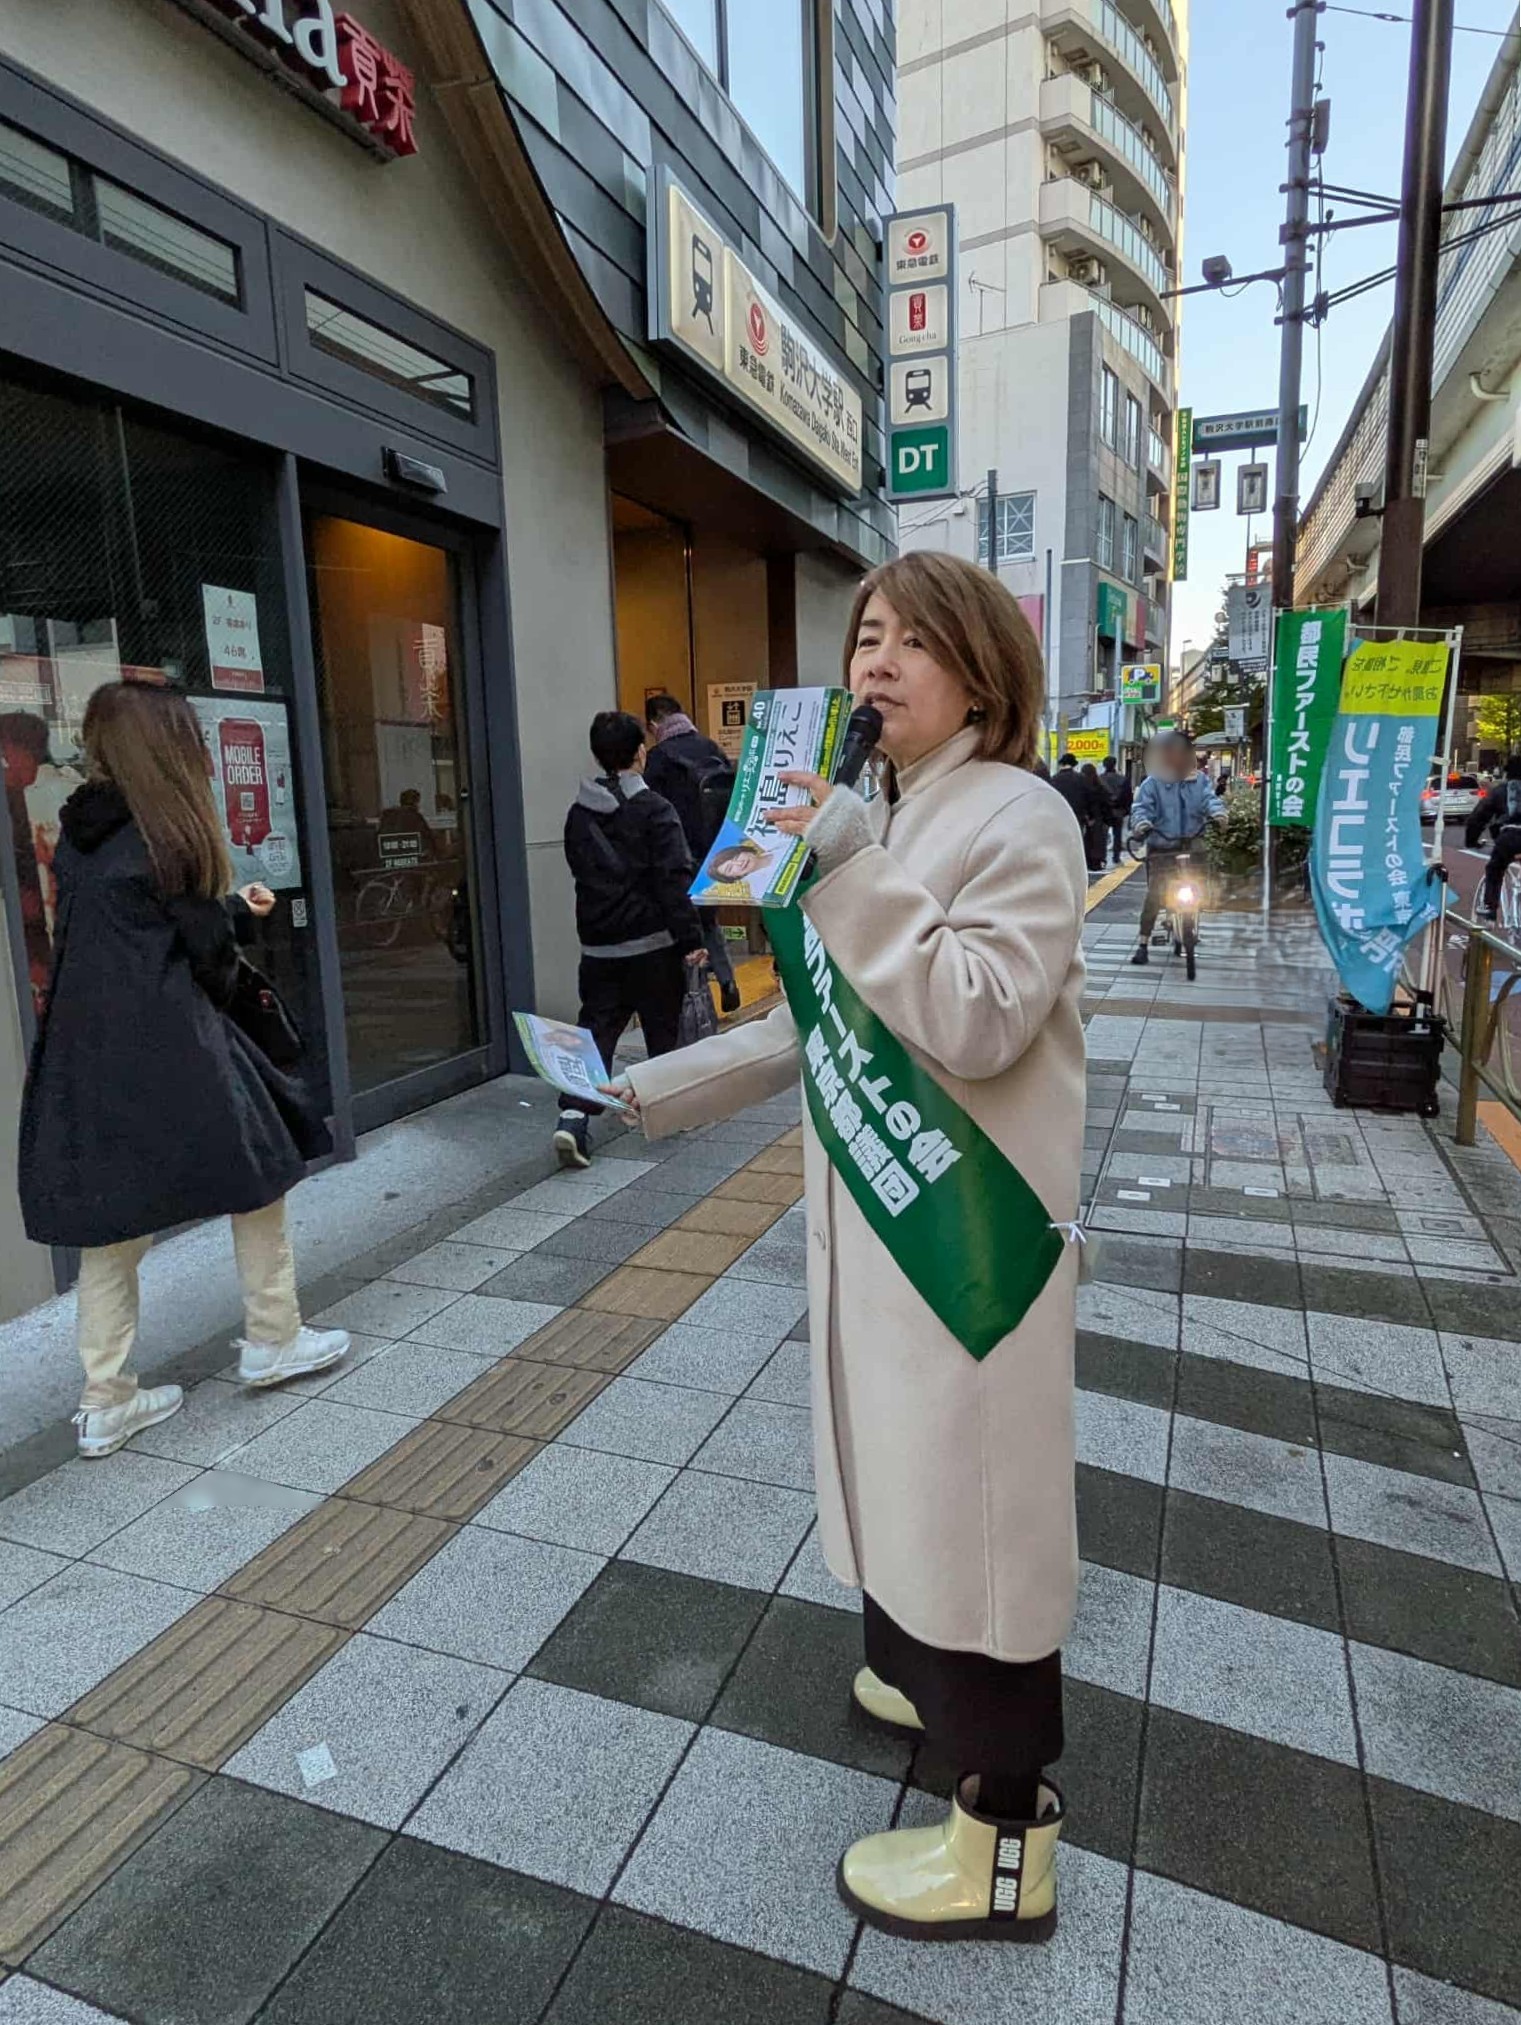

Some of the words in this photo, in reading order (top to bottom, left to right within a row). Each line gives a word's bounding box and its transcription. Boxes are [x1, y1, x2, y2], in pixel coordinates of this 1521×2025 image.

[739, 343, 775, 396] 東急電鉄
[780, 322, 845, 433] 駒沢大学駅
[846, 410, 858, 444] 西口
[780, 379, 811, 428] Komazawa
[897, 443, 939, 474] DT
[1281, 619, 1323, 817] 都民ファーストの会
[224, 744, 261, 766] MOBILE
[227, 765, 263, 785] ORDER
[805, 1022, 920, 1218] 東京都議団
[997, 1837, 1022, 1870] UGG
[993, 1876, 1018, 1912] UGG
